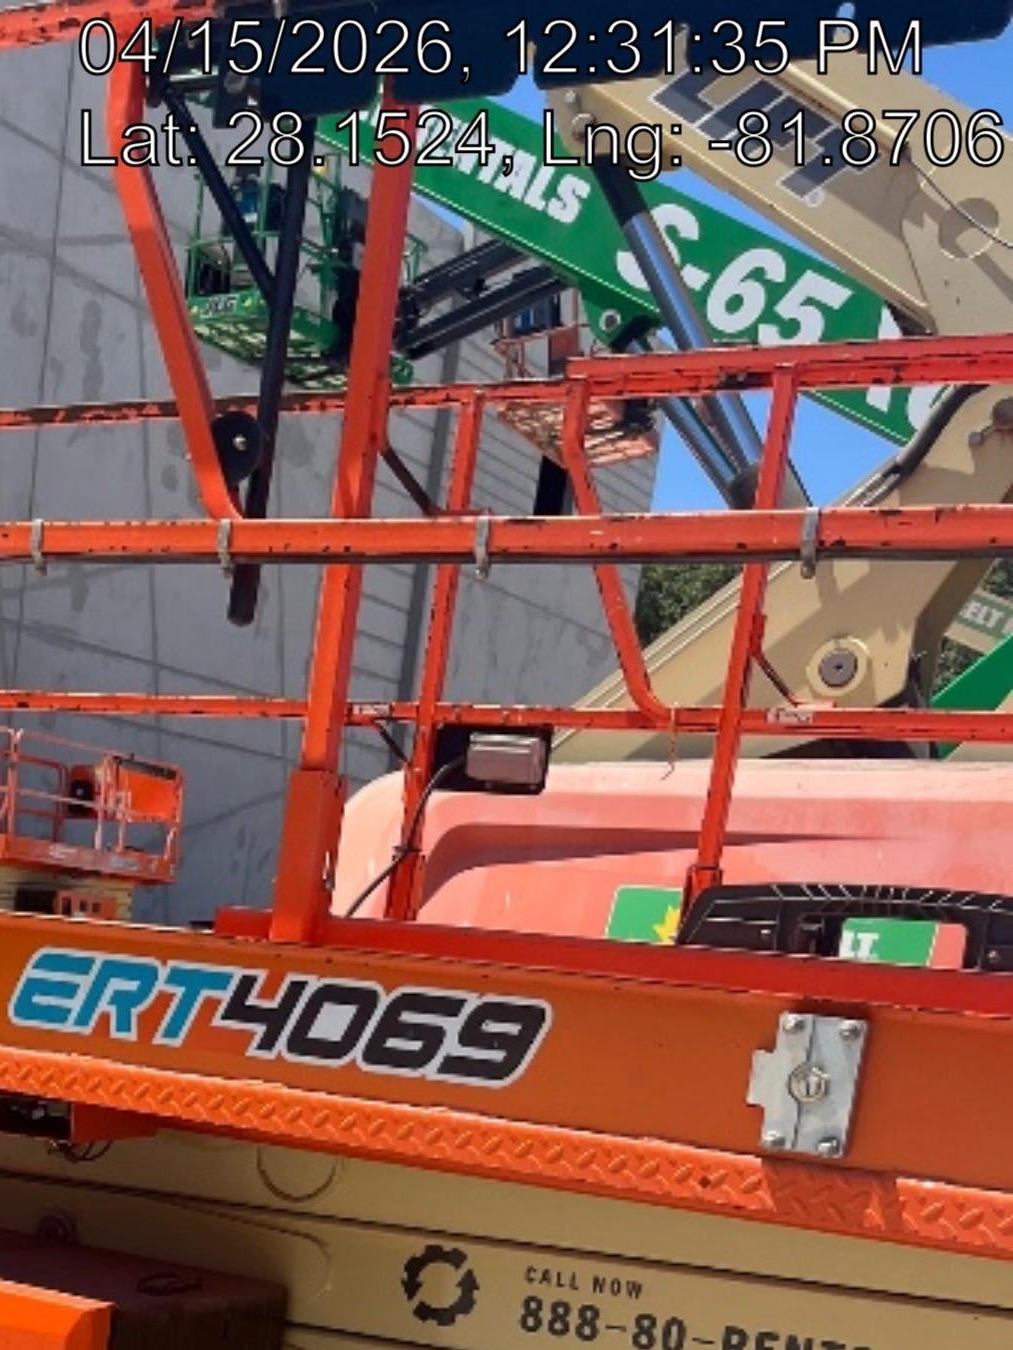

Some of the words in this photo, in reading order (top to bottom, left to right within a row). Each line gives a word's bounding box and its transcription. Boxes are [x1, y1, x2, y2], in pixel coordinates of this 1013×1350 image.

[7, 946, 554, 1088] ERT4069
[524, 1265, 580, 1291] CALL
[592, 1275, 643, 1299] NOW
